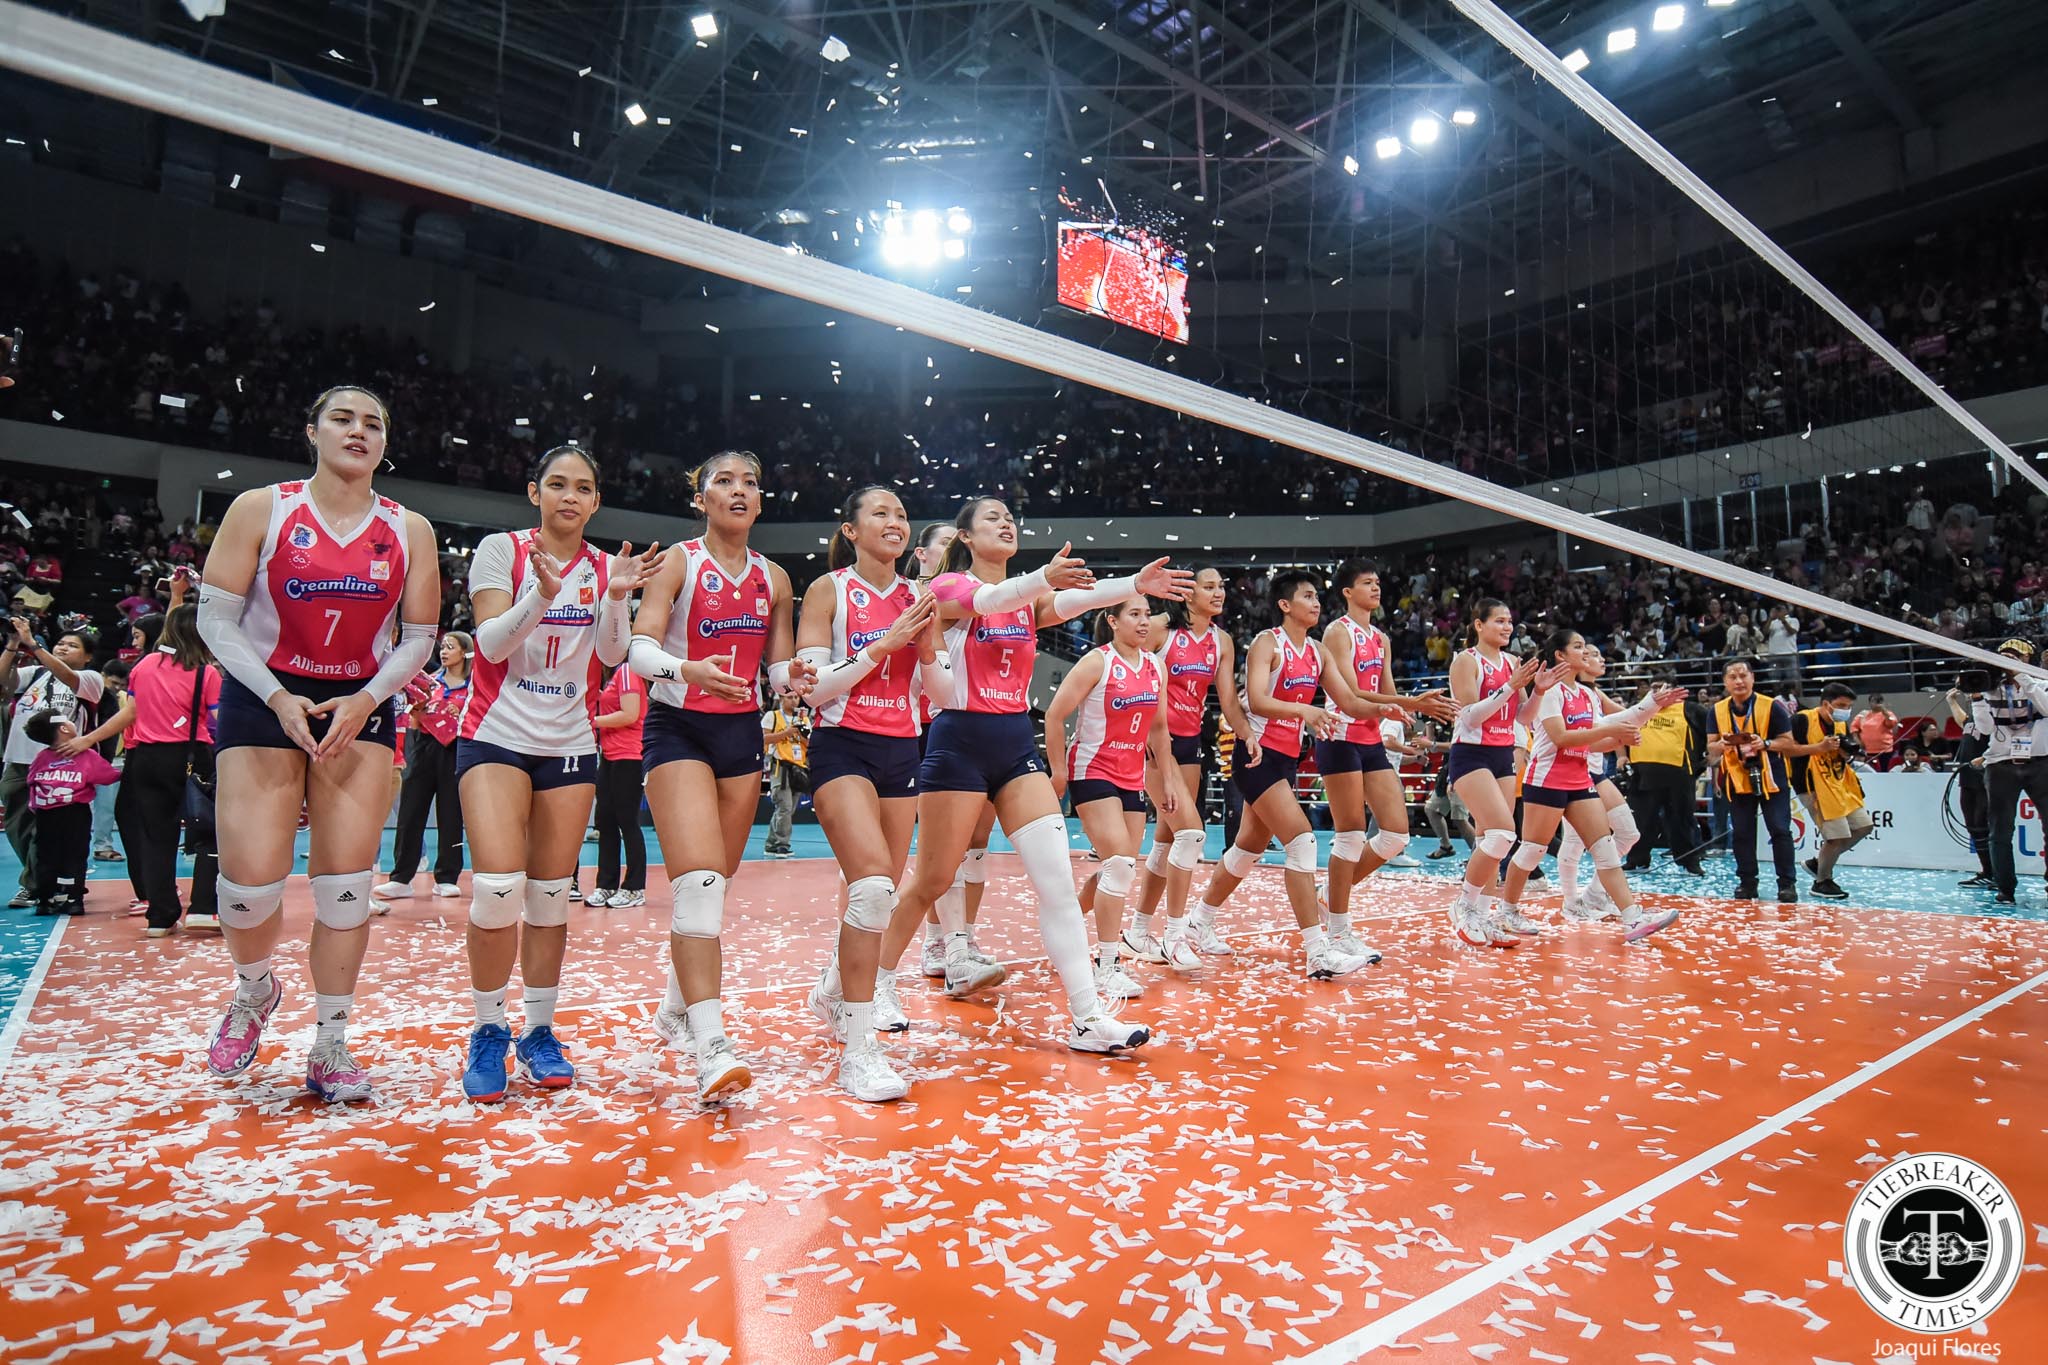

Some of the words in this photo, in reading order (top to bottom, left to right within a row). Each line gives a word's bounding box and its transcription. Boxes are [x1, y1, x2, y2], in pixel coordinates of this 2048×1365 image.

[286, 576, 377, 599] Creamline
[544, 605, 588, 618] amline
[324, 608, 342, 647] 7
[699, 614, 763, 638] Creamline
[976, 625, 1026, 642] Creamline
[850, 629, 890, 651] Cream
[545, 635, 560, 669] 11
[289, 654, 343, 675] Allianz
[881, 654, 891, 688] 4
[999, 648, 1014, 678] 5
[1170, 662, 1210, 675] Creamline
[516, 679, 561, 695] Allianz
[1370, 674, 1379, 693] 9
[857, 694, 895, 708] Allianz
[980, 687, 1014, 701] Allianz
[370, 716, 382, 734] 7
[1130, 712, 1142, 734] 8
[563, 756, 580, 773] 11
[1027, 759, 1038, 772] 5
